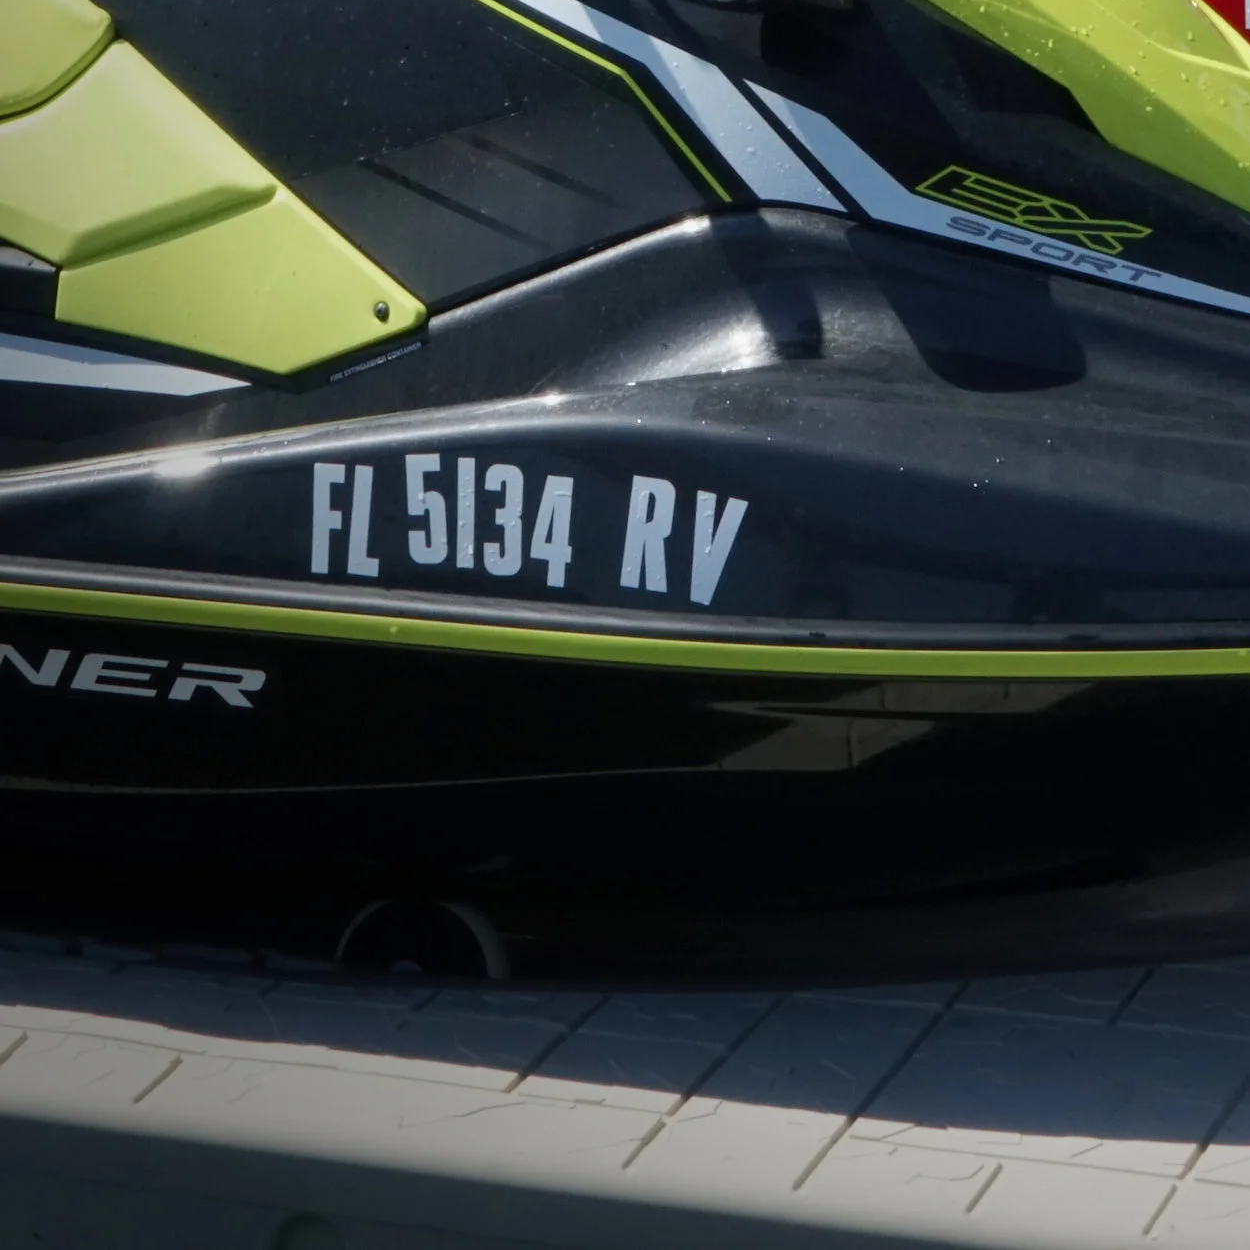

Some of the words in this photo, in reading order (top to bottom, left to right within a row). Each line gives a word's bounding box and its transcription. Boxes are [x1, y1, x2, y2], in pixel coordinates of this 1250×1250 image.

[914, 165, 1153, 255] EX
[946, 216, 1161, 282] SPORT
[311, 462, 380, 577] FL
[405, 453, 574, 588] 5134
[619, 475, 749, 606] RV
